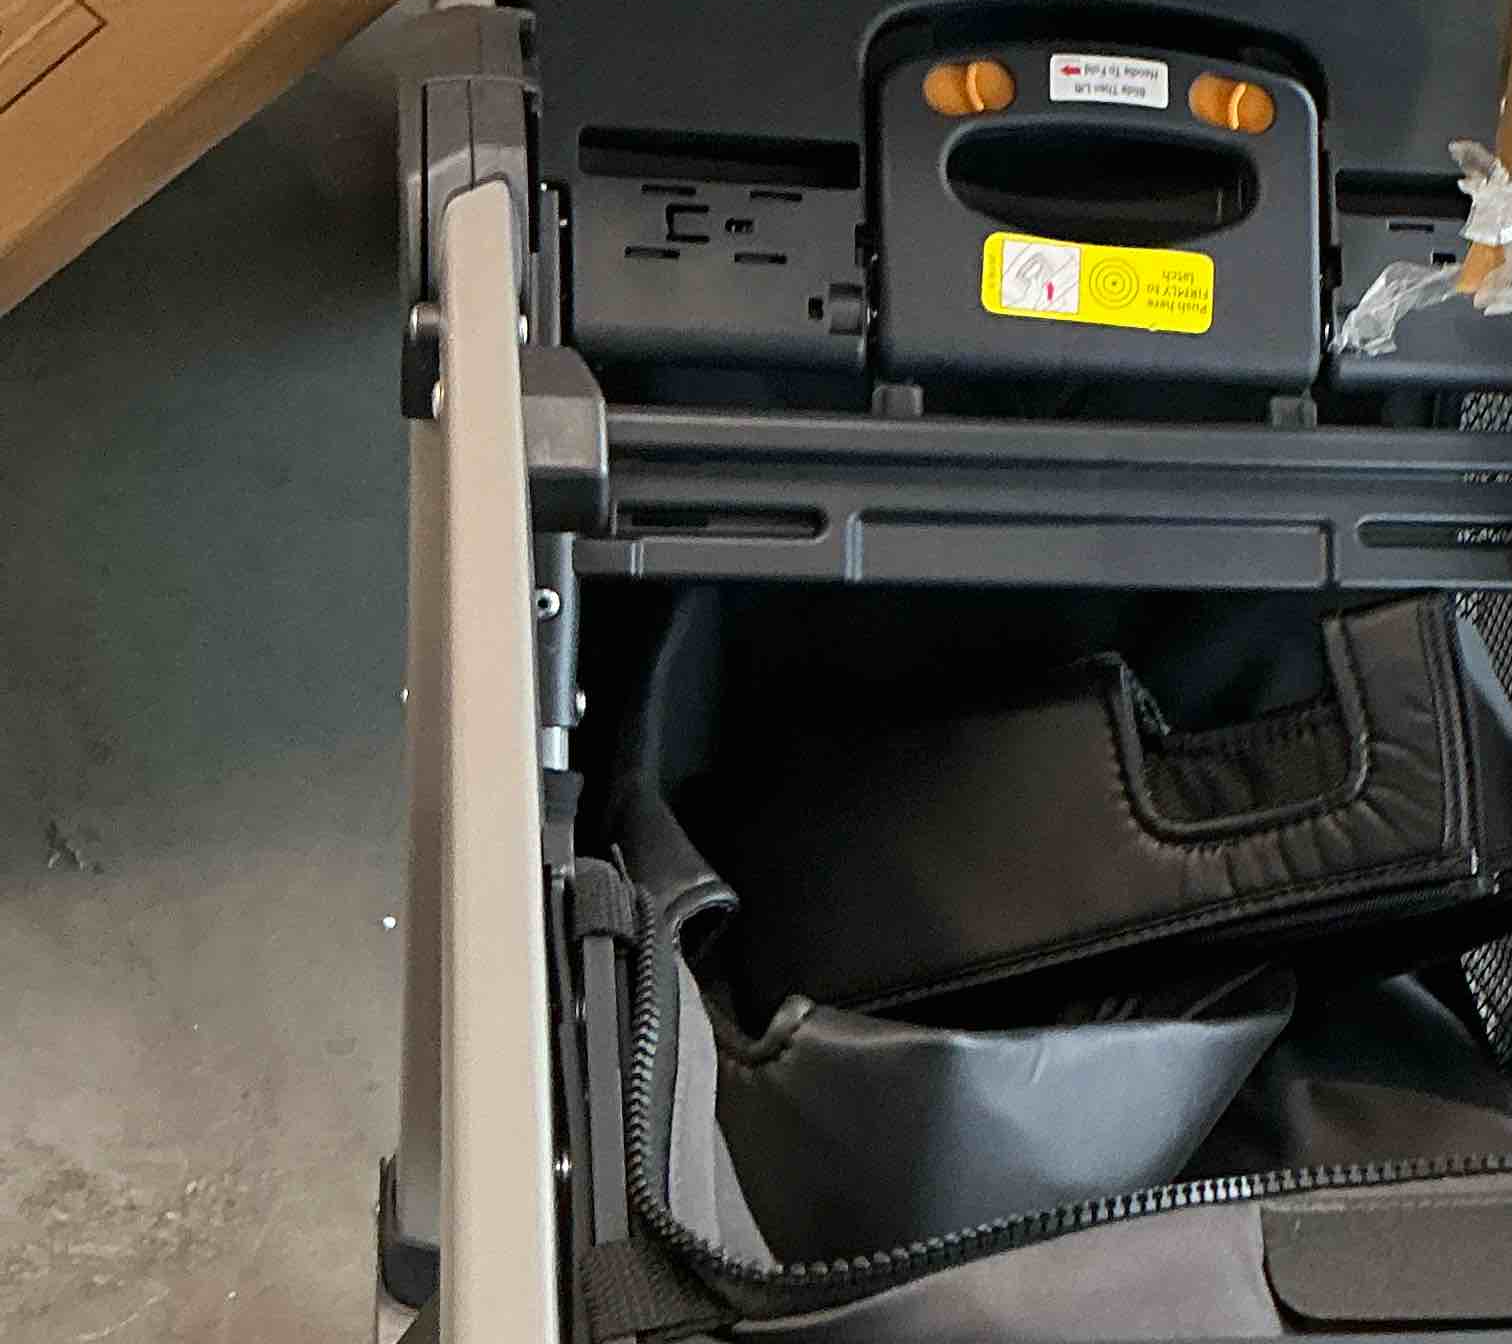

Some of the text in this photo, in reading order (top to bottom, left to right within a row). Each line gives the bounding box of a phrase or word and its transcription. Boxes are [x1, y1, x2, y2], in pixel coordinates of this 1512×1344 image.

[1162, 285, 1208, 301] FIRMLY
[1147, 298, 1208, 315] Push here
